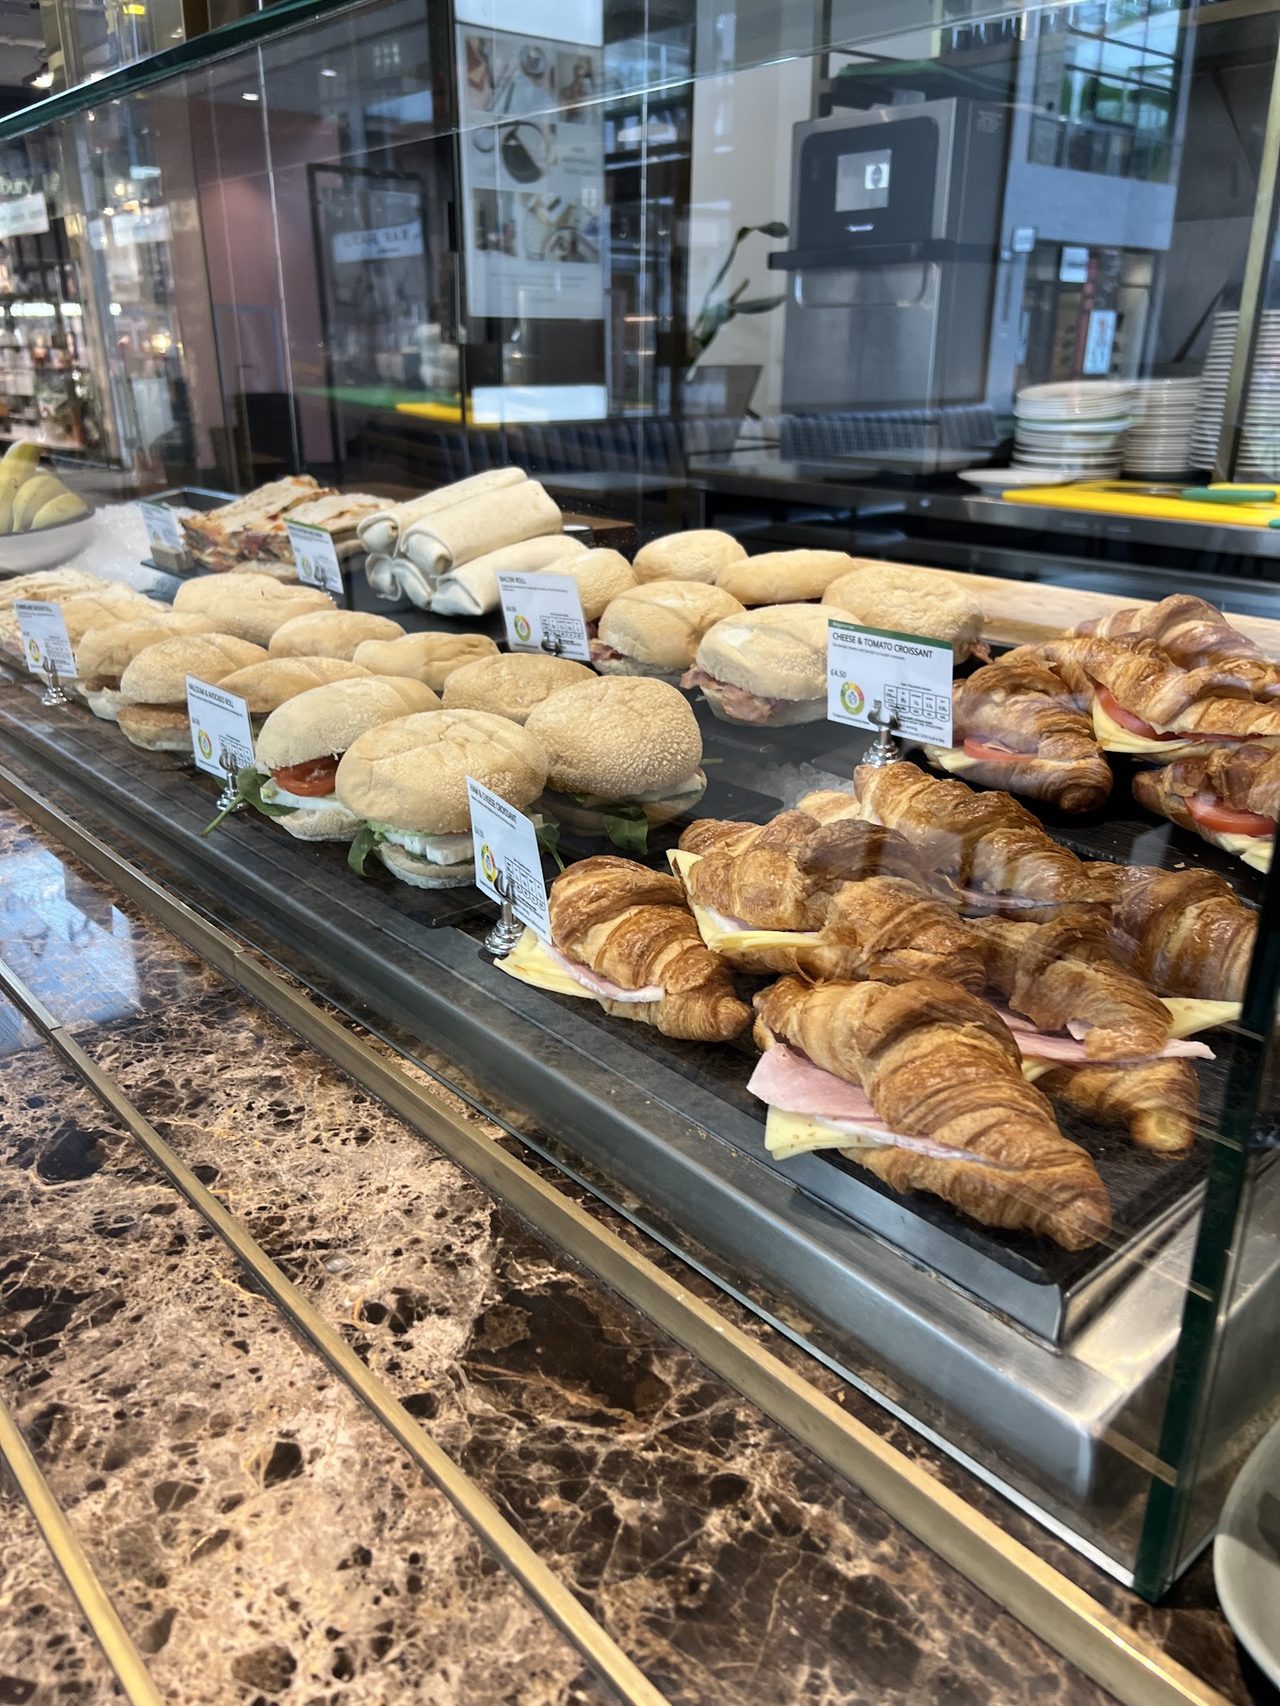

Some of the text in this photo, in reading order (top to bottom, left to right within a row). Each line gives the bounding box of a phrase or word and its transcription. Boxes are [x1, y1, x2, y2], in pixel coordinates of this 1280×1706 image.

[832, 631, 856, 644] CHEESE
[857, 637, 863, 645] &
[864, 638, 893, 651] TOMATO
[894, 643, 933, 659] CROISSANT
[830, 668, 847, 679] £4.50
